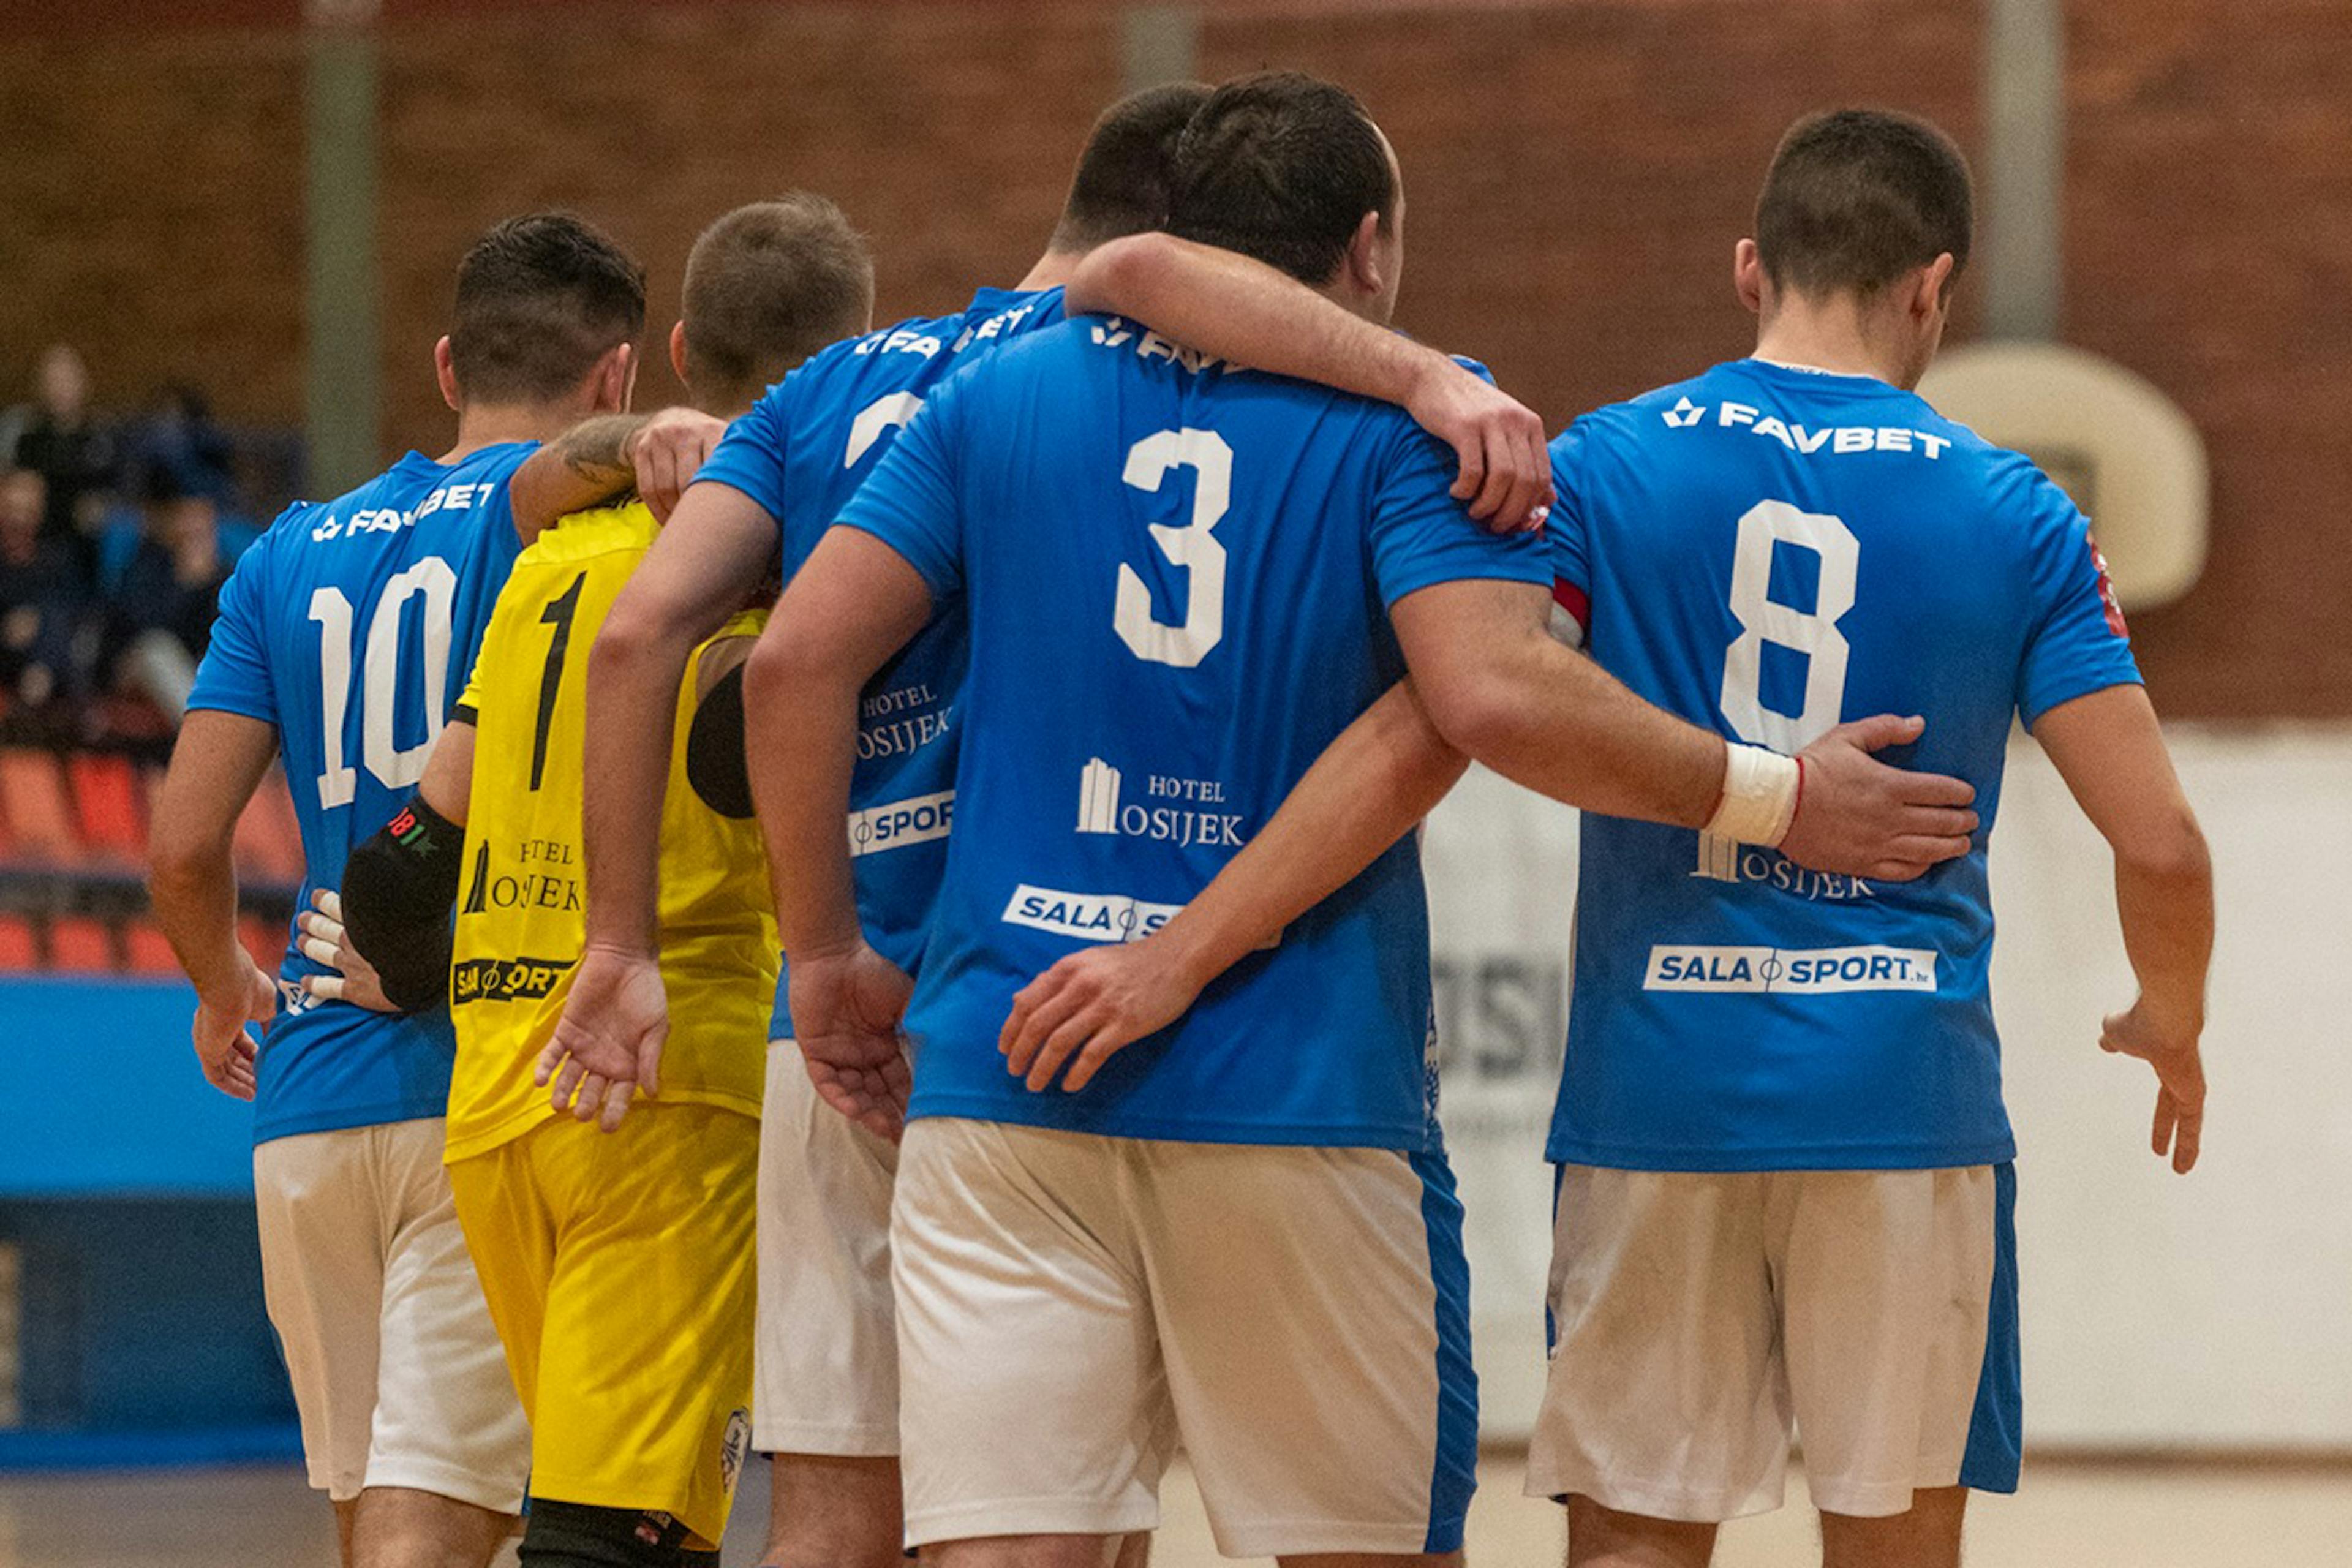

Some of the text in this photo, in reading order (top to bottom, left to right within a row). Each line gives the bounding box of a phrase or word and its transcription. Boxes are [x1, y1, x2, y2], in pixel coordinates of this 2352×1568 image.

[1719, 402, 1951, 459] FAVBET
[346, 483, 494, 537] FAVBET
[1113, 427, 1234, 668] 3
[1720, 499, 1860, 754] 8
[308, 556, 458, 810] 10
[529, 570, 587, 791] 1
[863, 684, 937, 718] HOTEL
[858, 705, 954, 760] OSIJEK
[1148, 775, 1225, 803] HOTEL
[1121, 804, 1245, 848] OSIJEK
[1743, 853, 1876, 901] OSIJEK
[1020, 896, 1112, 930] SALA
[1658, 956, 1751, 982] SALA
